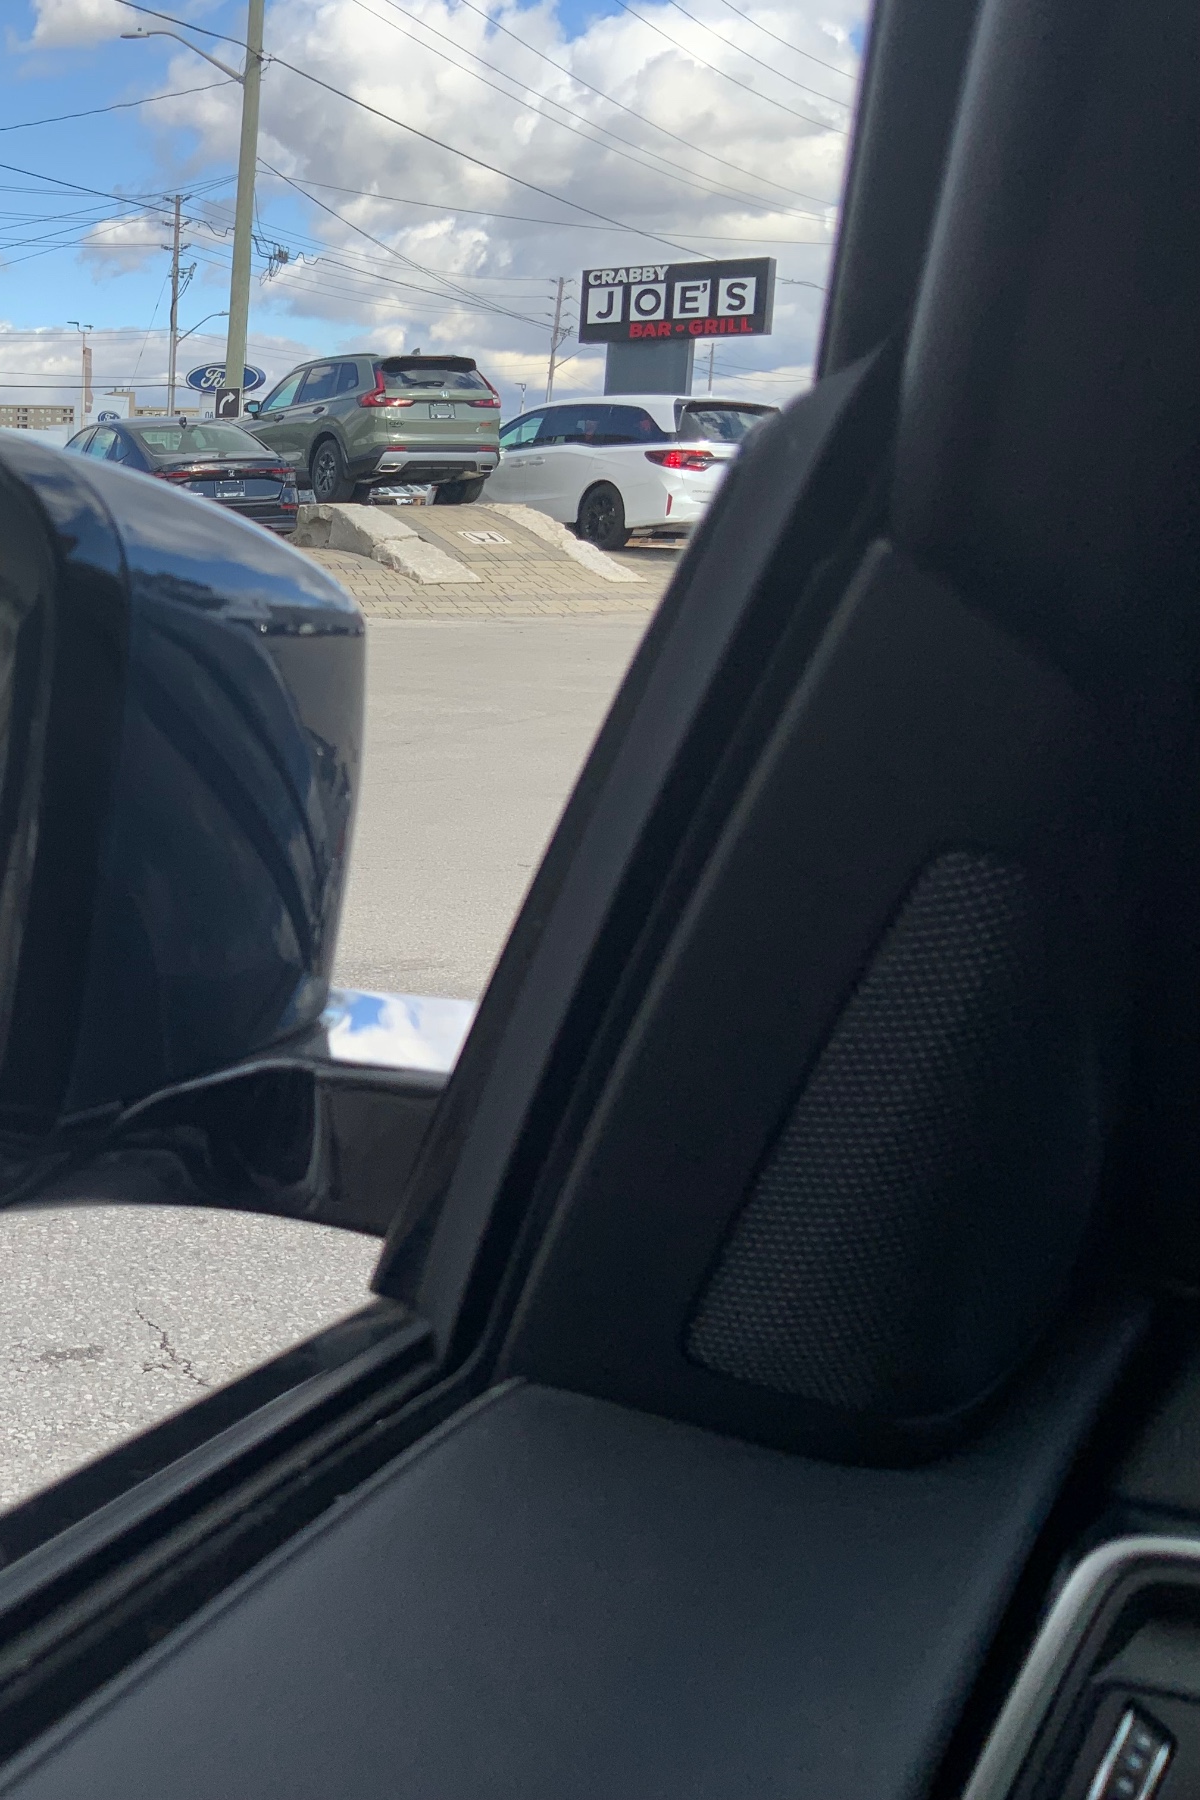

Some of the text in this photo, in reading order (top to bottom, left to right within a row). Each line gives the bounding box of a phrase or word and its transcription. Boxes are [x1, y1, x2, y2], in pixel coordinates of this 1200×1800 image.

[588, 266, 669, 286] CRABBY
[595, 281, 749, 319] JOE'S
[629, 316, 752, 338] BAR GRILL
